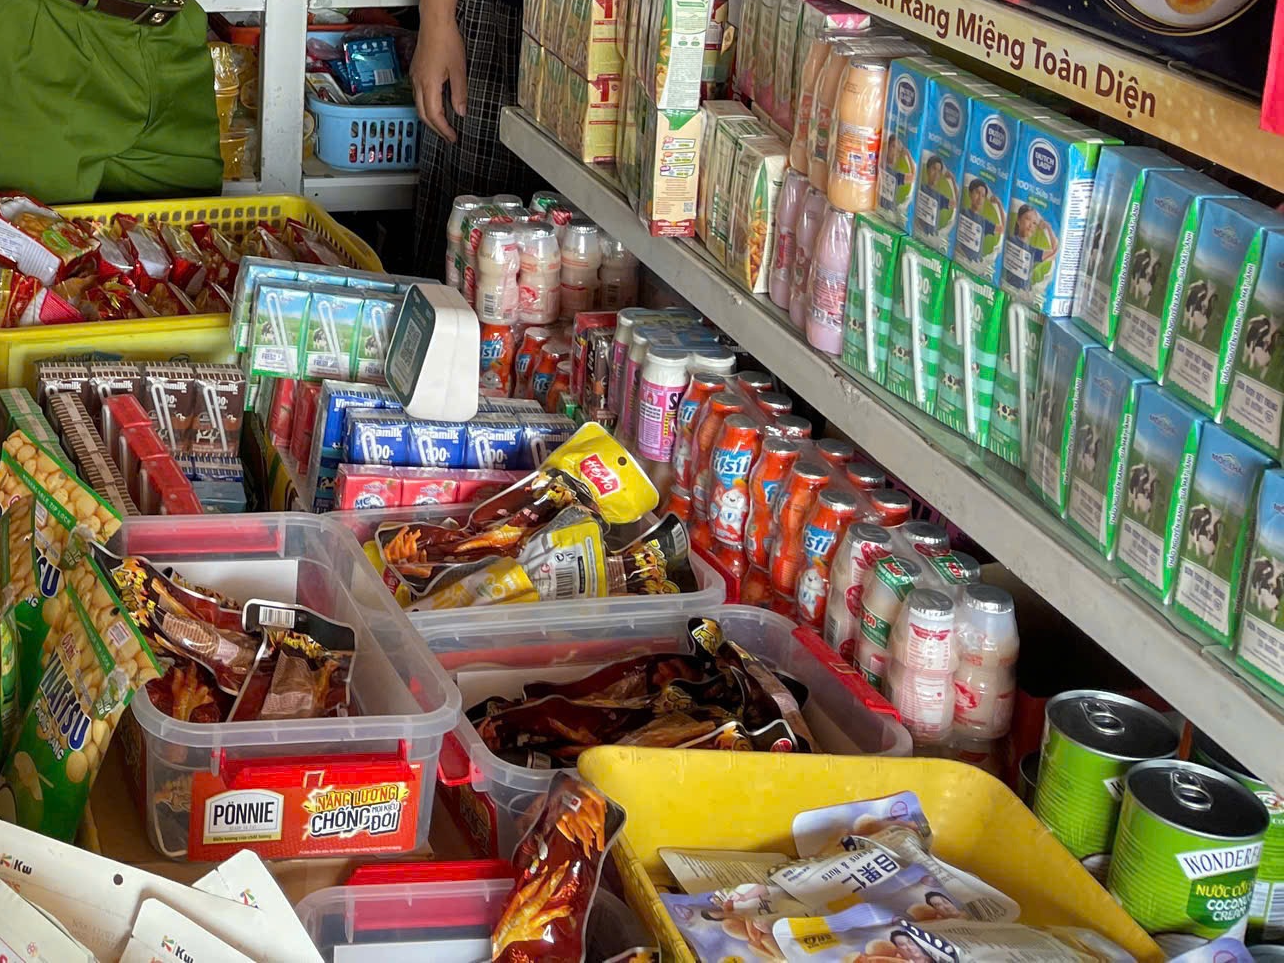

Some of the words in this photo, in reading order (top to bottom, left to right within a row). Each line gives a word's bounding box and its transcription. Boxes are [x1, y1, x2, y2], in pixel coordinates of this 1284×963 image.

[956, 8, 1025, 70] Miệng
[1032, 37, 1088, 89] Toàn
[1094, 63, 1157, 118] Diện
[1034, 151, 1055, 166] DUTCH
[1036, 160, 1052, 173] LADY
[213, 801, 275, 826] PÖNNIE
[311, 807, 371, 833] CHỐNG
[821, 866, 842, 882] Nuts
